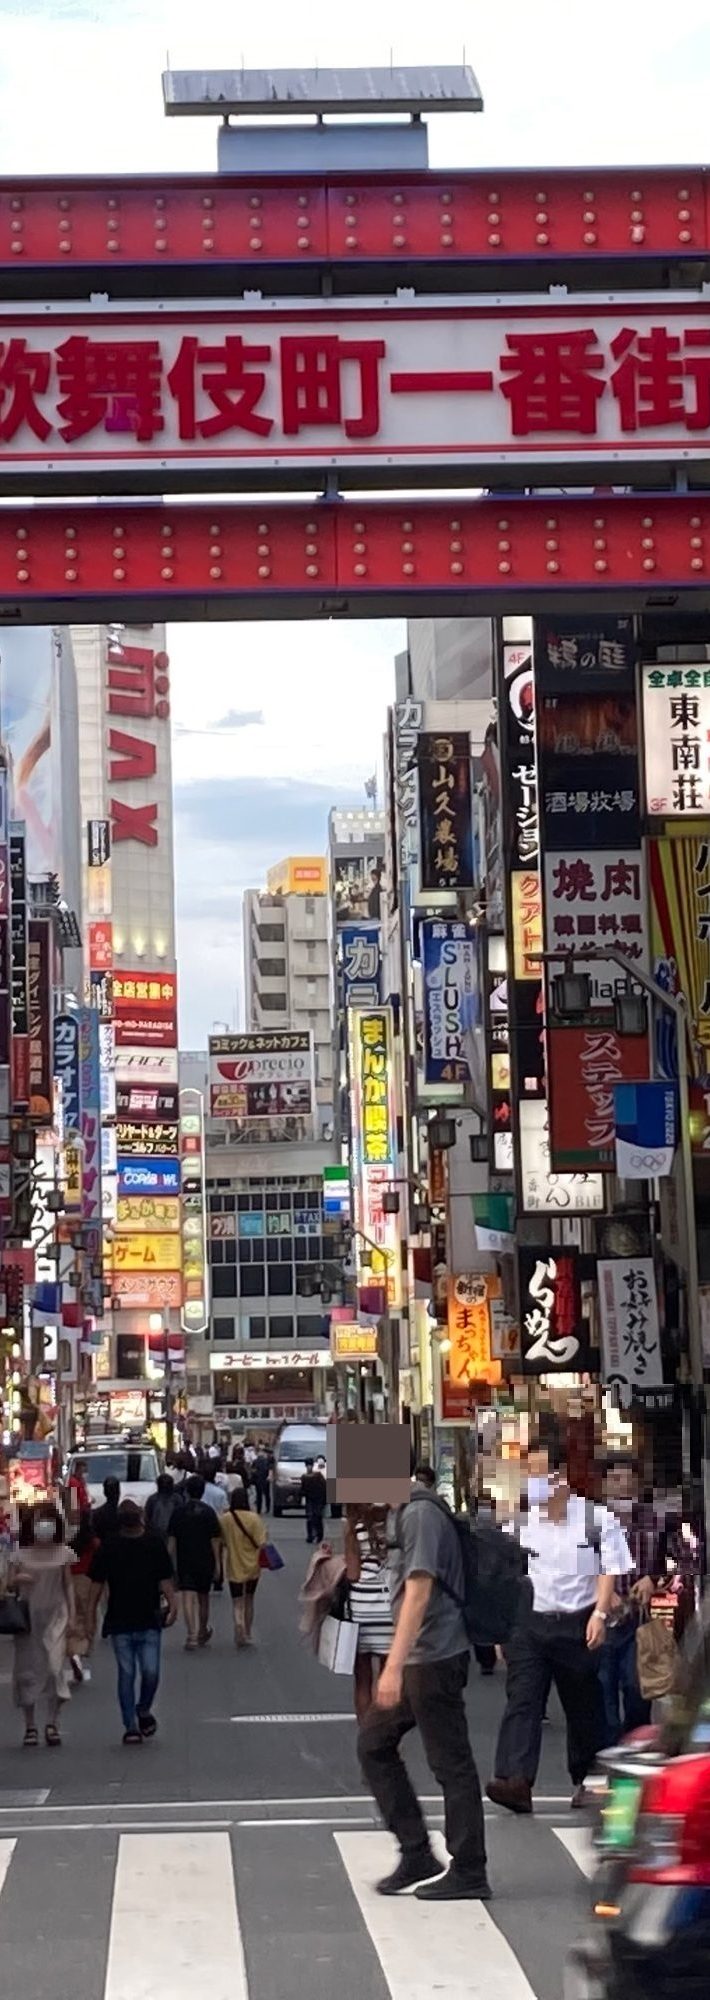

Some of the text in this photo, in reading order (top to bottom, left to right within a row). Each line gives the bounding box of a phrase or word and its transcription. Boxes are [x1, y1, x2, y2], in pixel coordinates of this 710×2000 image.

[508, 653, 525, 664] 4F
[669, 693, 703, 811] 東南荘
[546, 791, 636, 813] 酒場牧場
[432, 923, 467, 939] 麻雀
[520, 877, 541, 975] クアトロ
[443, 944, 461, 1057] SLUSH
[55, 1022, 77, 1110] カラオケ
[116, 1246, 156, 1263] ゲーム
[619, 1268, 657, 1376] お好み焼き
